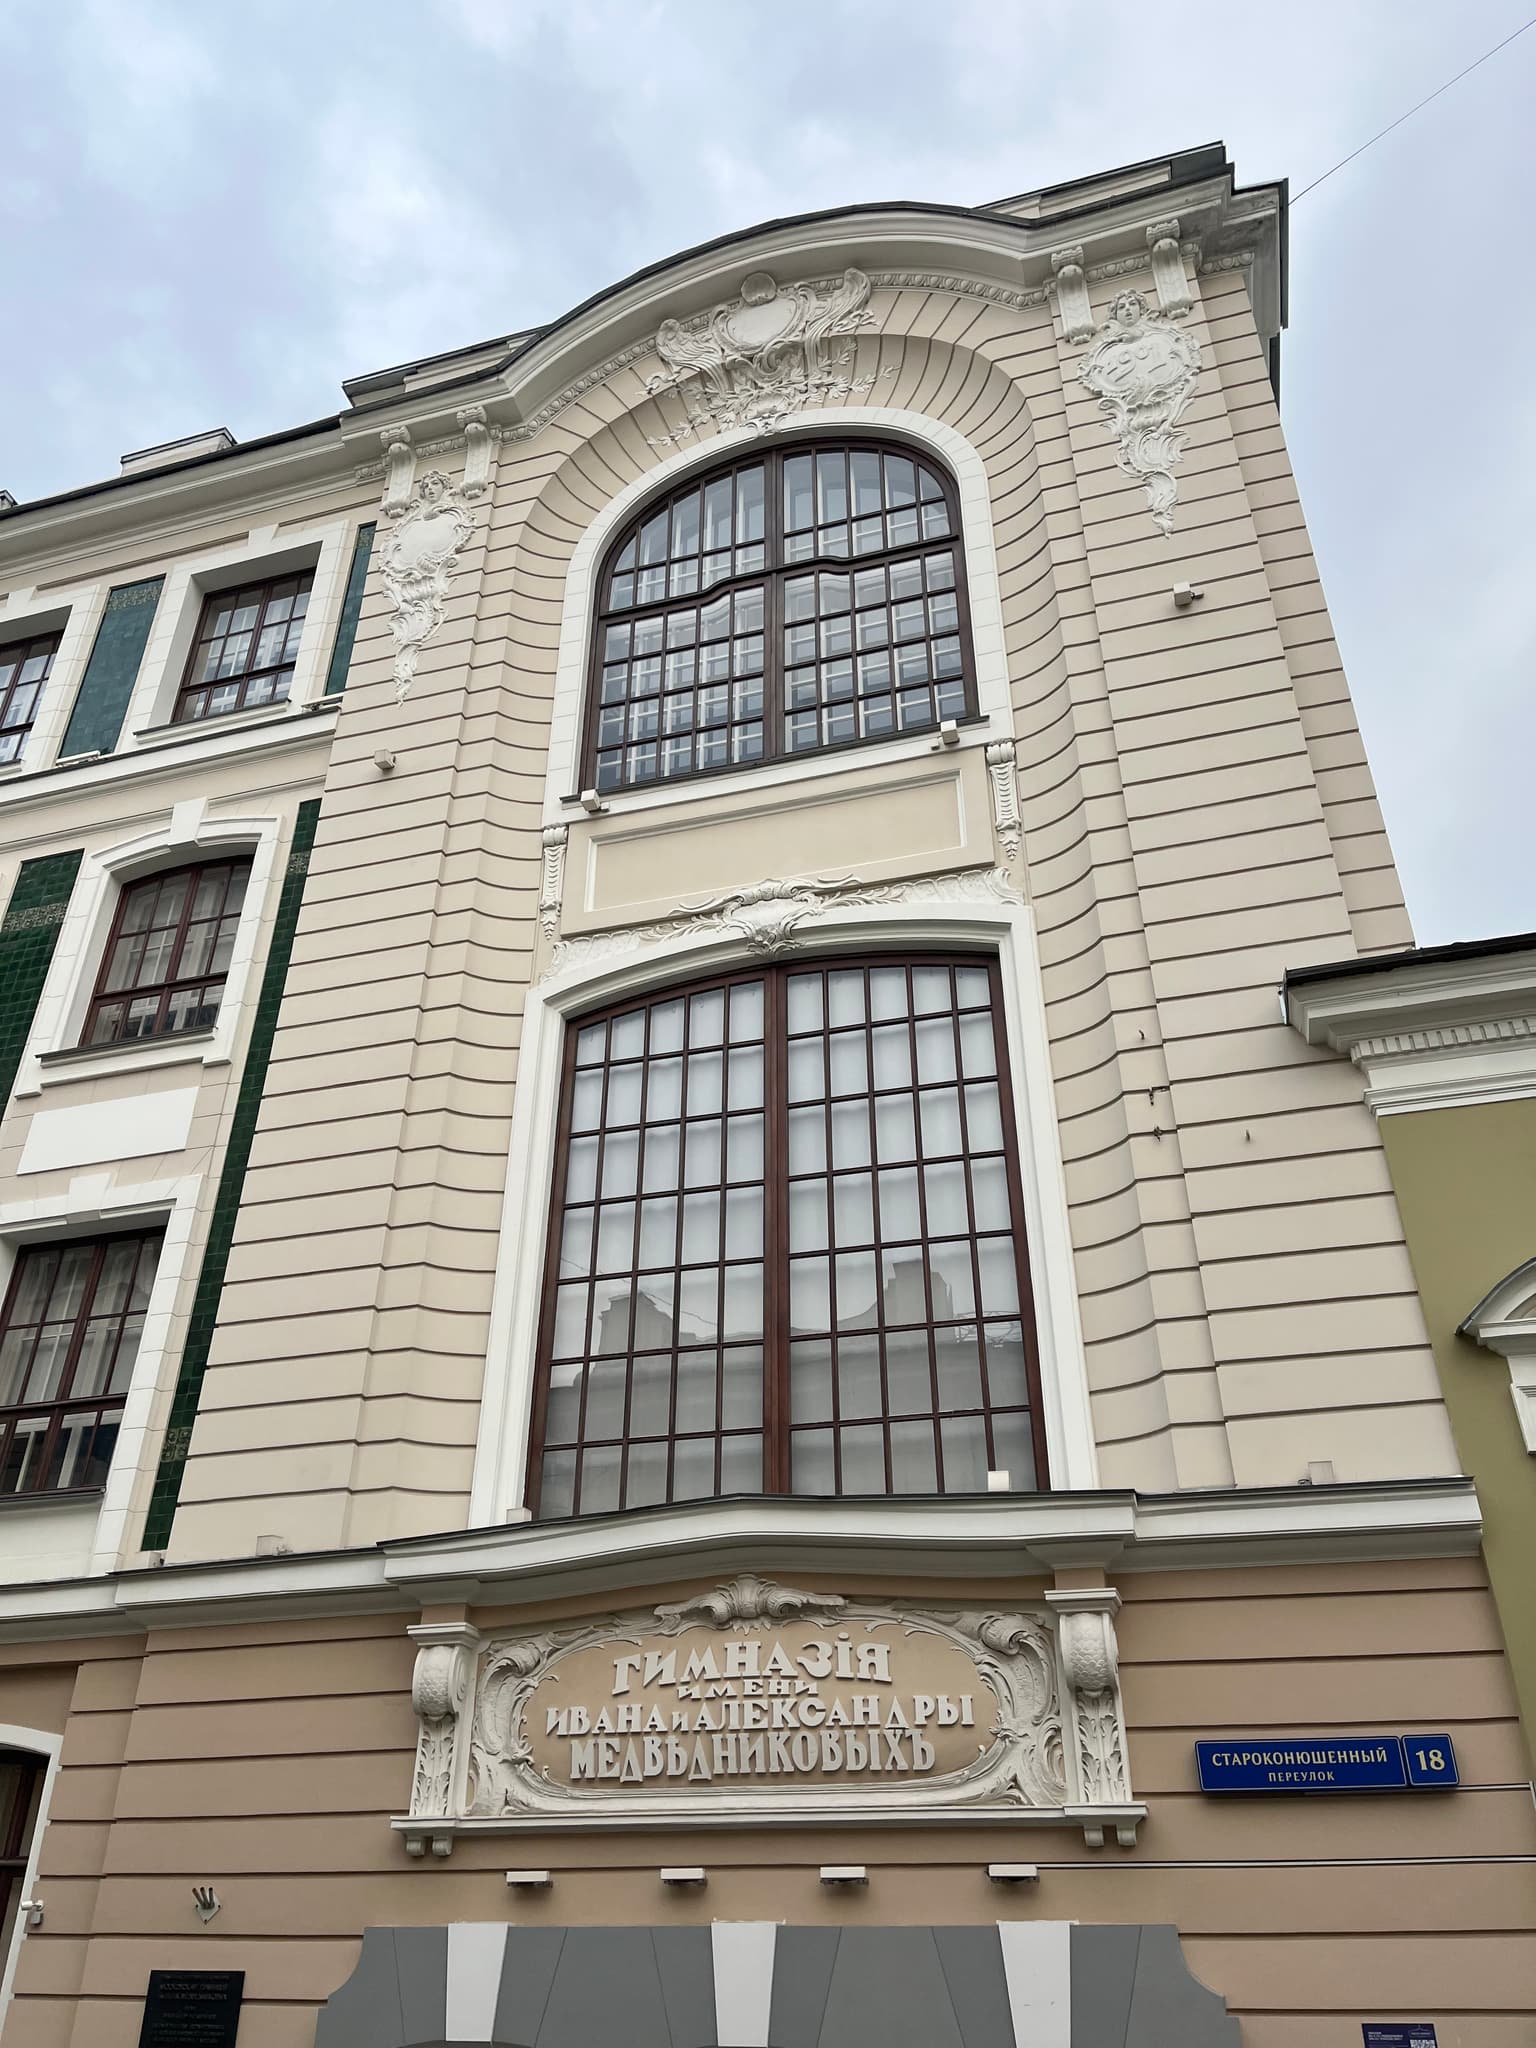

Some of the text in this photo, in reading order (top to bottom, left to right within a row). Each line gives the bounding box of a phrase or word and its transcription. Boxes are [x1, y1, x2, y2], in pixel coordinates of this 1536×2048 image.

[612, 1632, 893, 1696] ГИМНАЗІЯ
[546, 1704, 669, 1736] ИВАНА
[692, 1695, 975, 1731] АЛЕКСАНДРЫ
[1211, 1747, 1388, 1767] СТАРОКОНЮШЕННЫЙ
[1415, 1749, 1446, 1771] 18
[1268, 1770, 1335, 1783] ПЕРЕУЛОК
